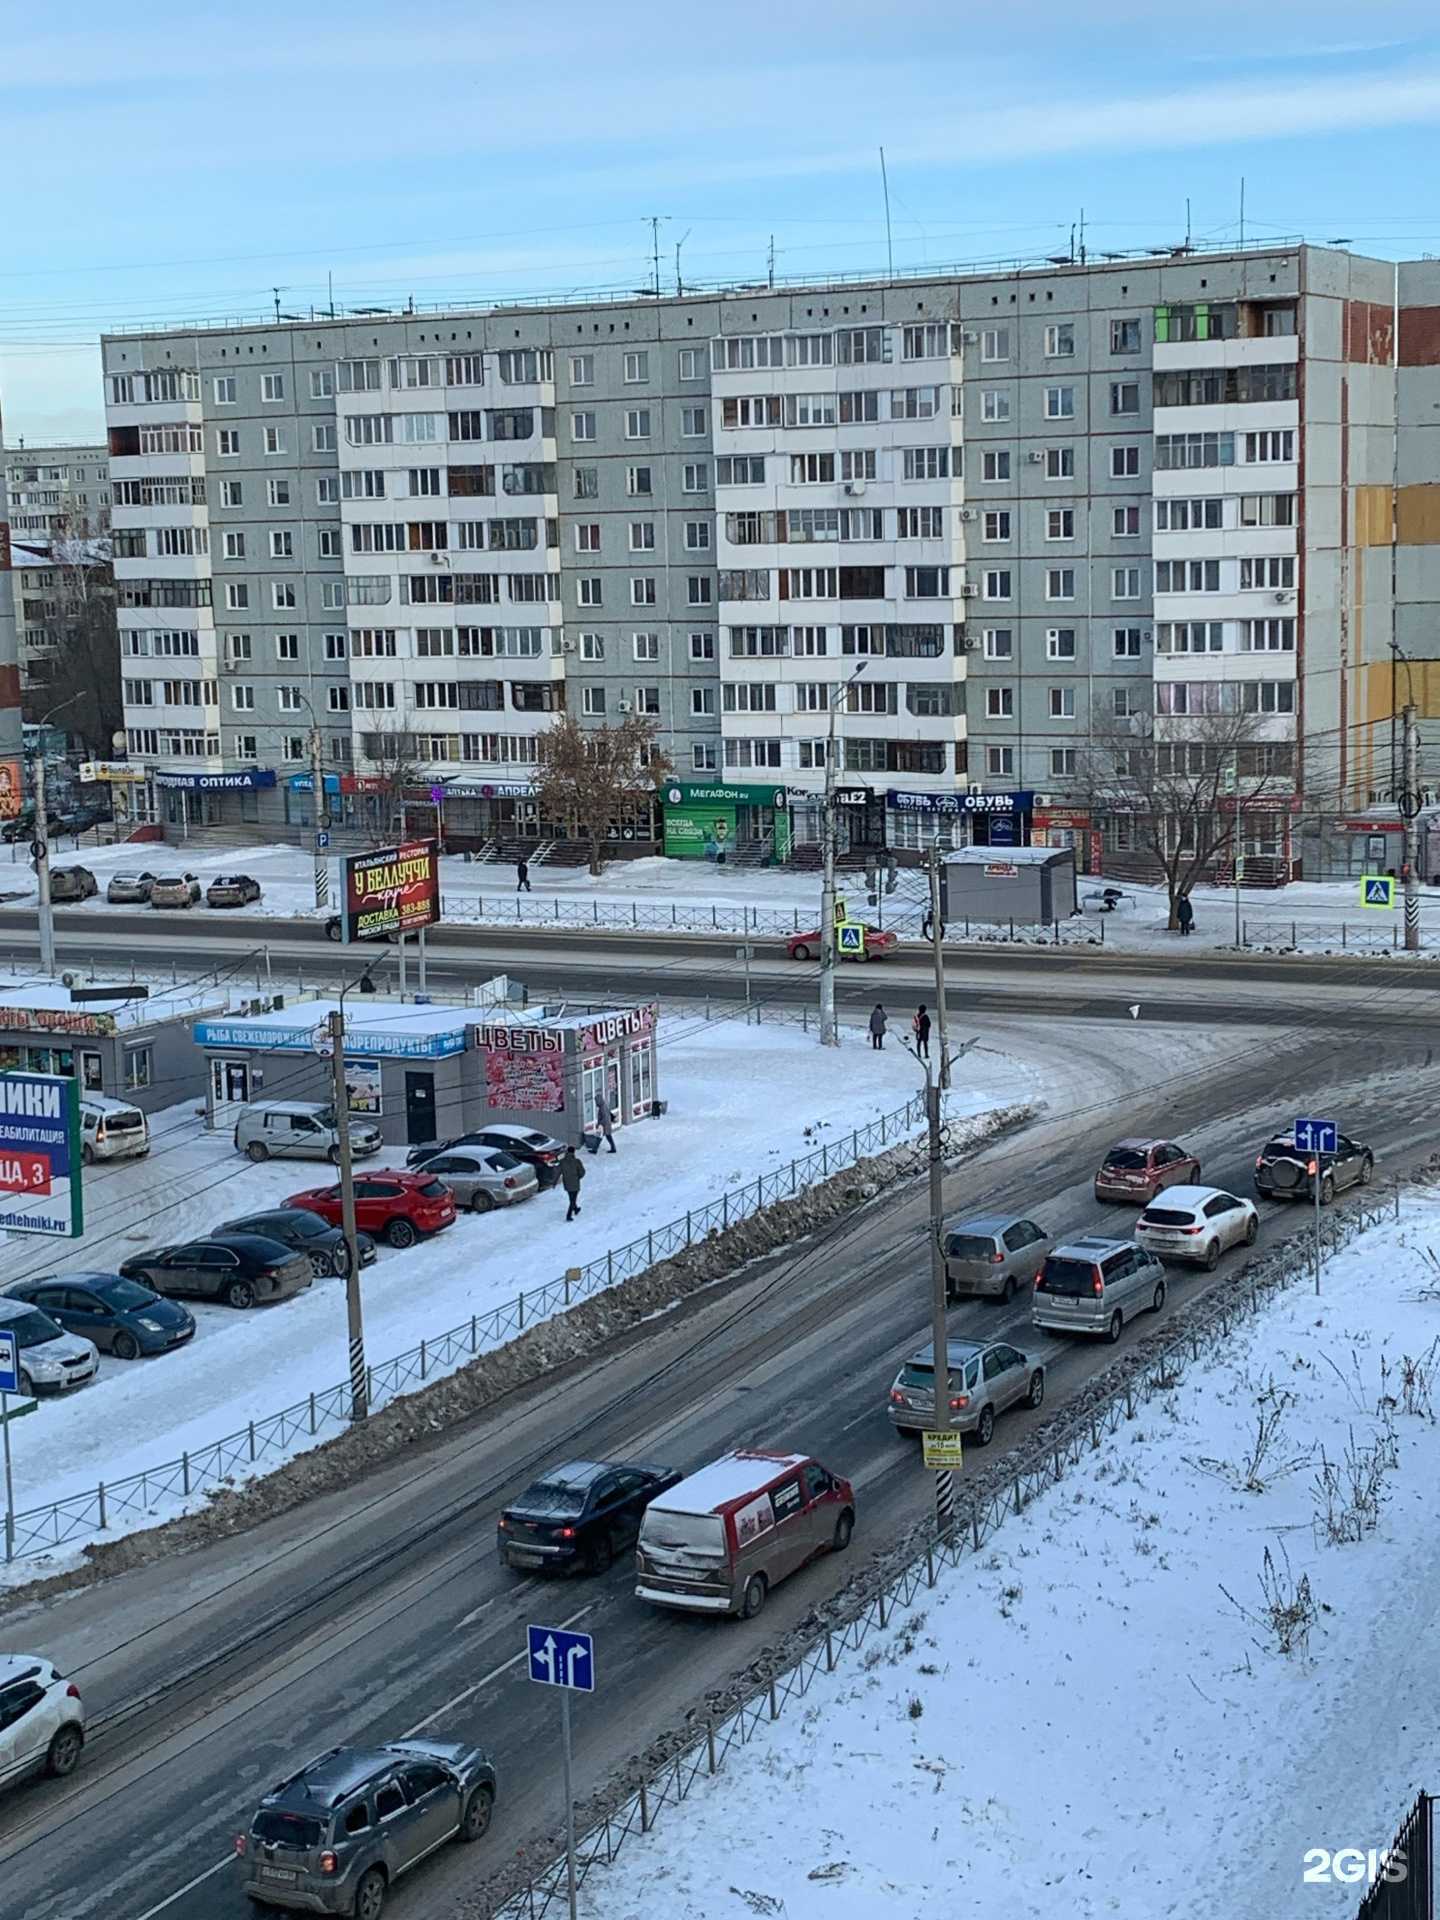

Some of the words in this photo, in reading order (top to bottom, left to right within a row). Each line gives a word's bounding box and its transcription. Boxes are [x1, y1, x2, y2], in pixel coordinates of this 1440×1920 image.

[200, 776, 252, 787] ОПТИКА
[897, 793, 931, 806] ОБУВЬ
[965, 795, 1013, 807] ОБУВЬ
[354, 873, 364, 895] У
[367, 857, 430, 893] БЕЛЛУЧЧИ
[358, 908, 399, 928] ДОСТАВКА
[596, 1012, 644, 1044] ЦВЕТЫ
[474, 1025, 565, 1053] ЦВЕТЫ
[0, 1082, 61, 1118] ИКИ
[0, 1125, 65, 1144] ЕАБИЛИТАЦИЯ
[0, 1160, 28, 1186] ЦА,
[0, 1213, 66, 1232] edtehniki.ru
